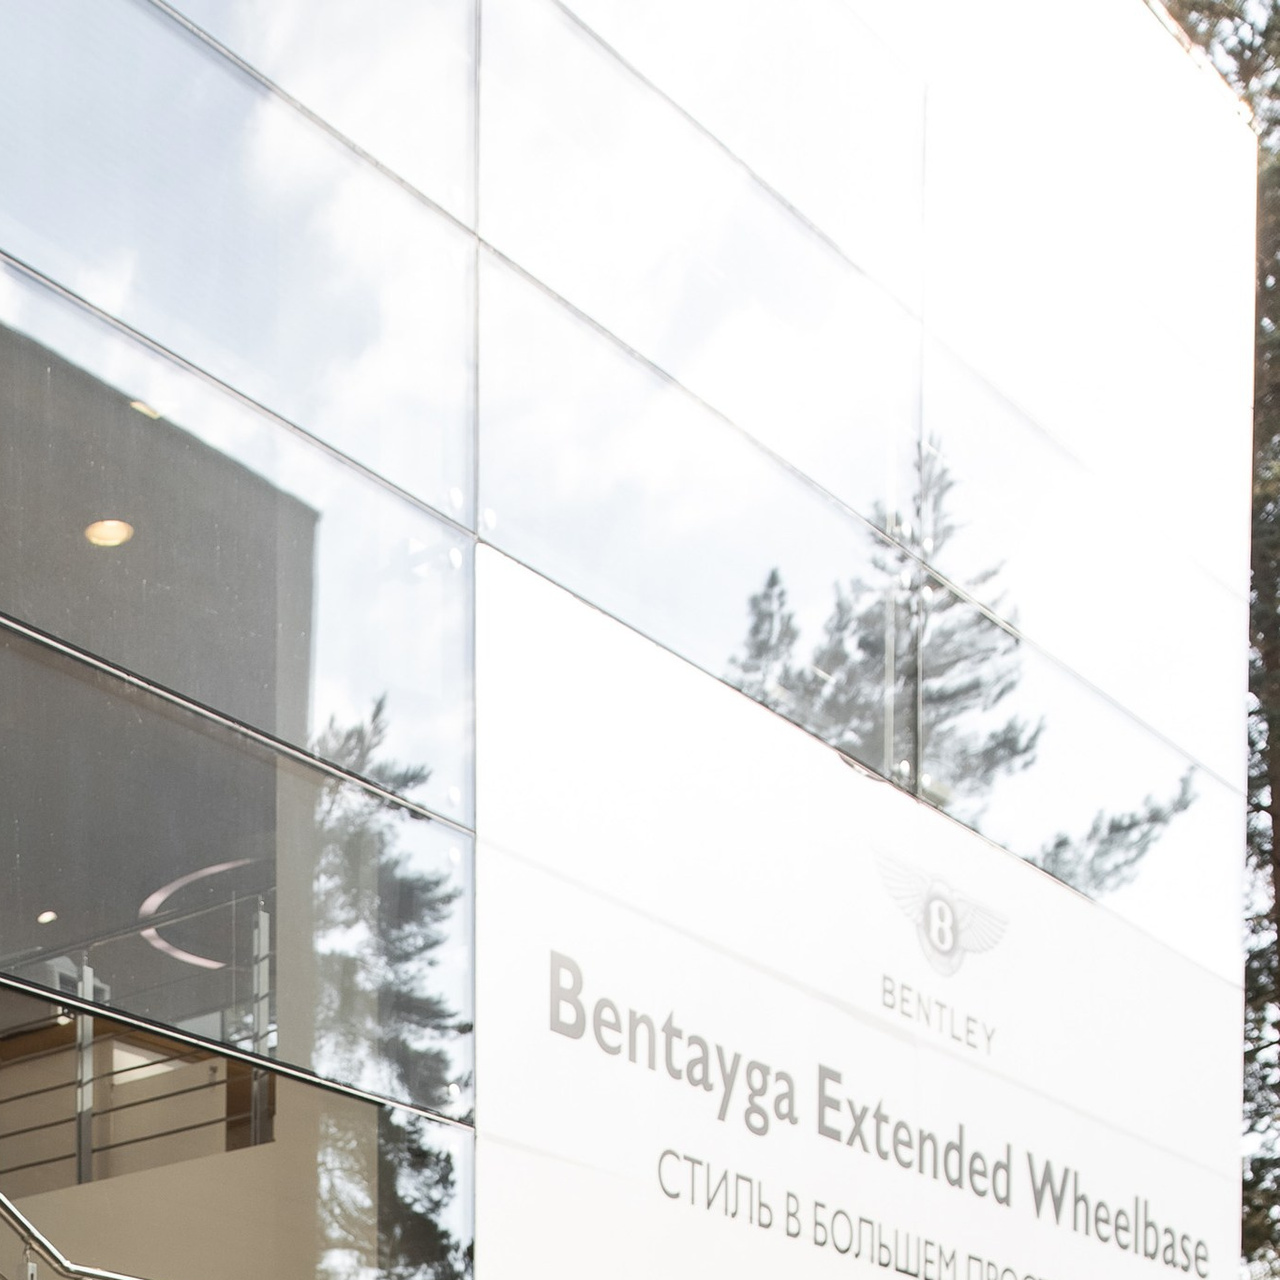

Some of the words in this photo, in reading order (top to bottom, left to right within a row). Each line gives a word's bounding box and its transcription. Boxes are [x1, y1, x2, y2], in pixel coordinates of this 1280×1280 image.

[881, 974, 996, 1056] BENTLEY
[548, 949, 799, 1137] Bentayga
[817, 1062, 1013, 1208] Extended
[1025, 1150, 1210, 1280] Wheelbase
[656, 1148, 774, 1230] СТИЛЬ
[784, 1190, 802, 1239] В
